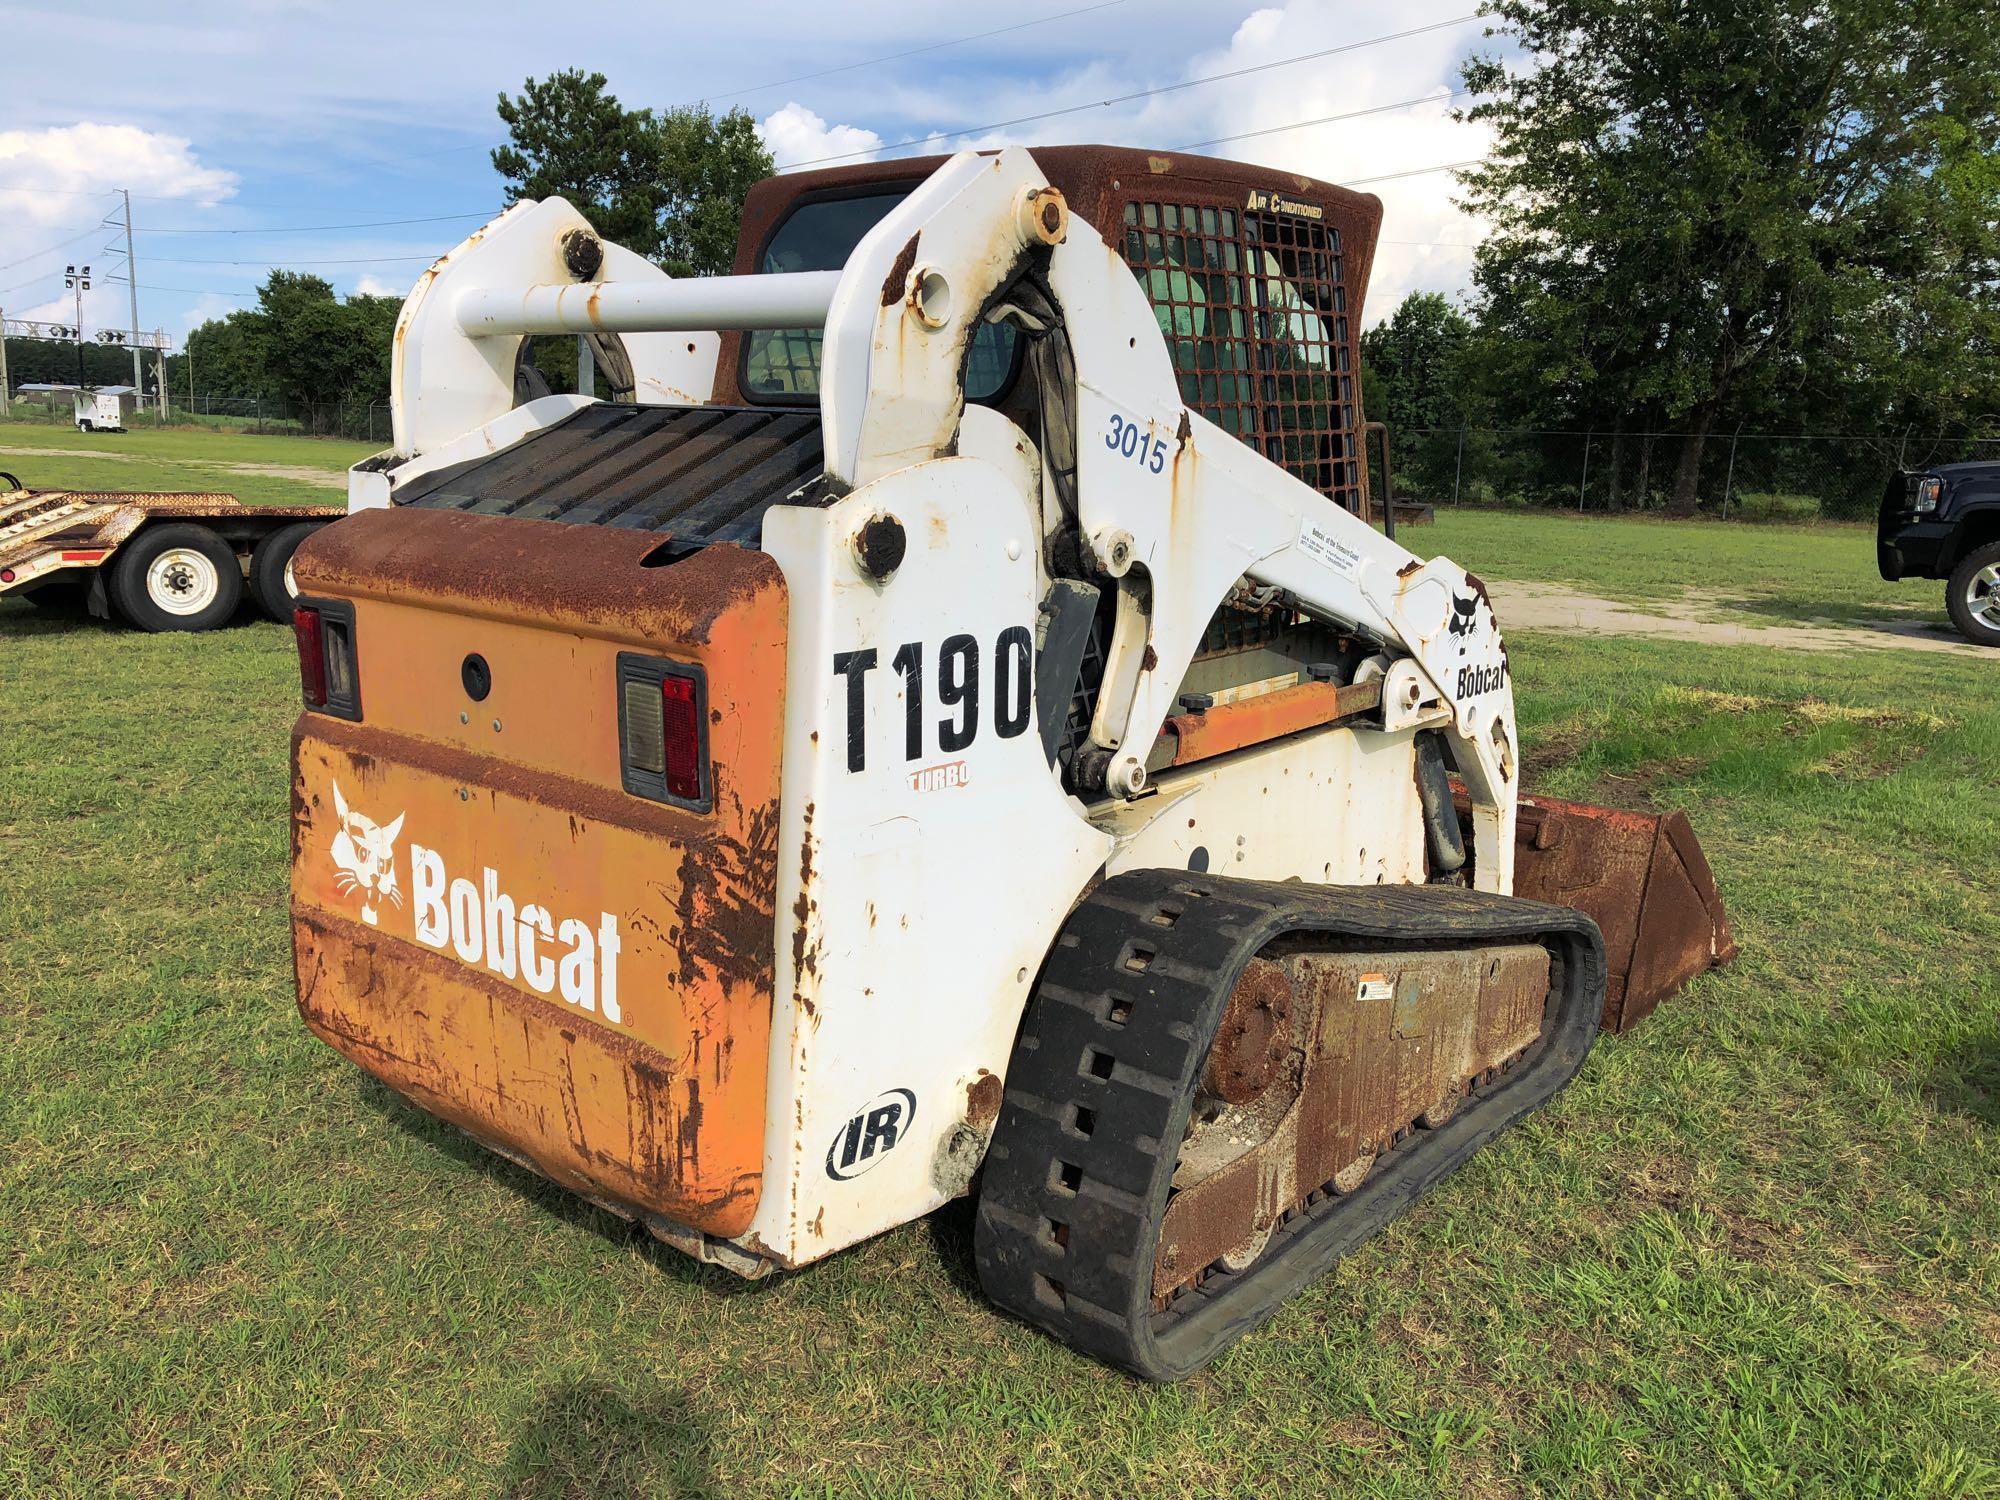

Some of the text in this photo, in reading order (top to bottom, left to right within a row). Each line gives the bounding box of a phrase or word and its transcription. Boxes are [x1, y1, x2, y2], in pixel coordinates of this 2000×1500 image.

[1105, 413, 1168, 474] 3015
[833, 626, 1032, 773] T190
[1457, 660, 1506, 701] Bobcat
[906, 761, 970, 793] TURBO
[410, 844, 621, 1024] Bobcat
[840, 1103, 902, 1169] IR
